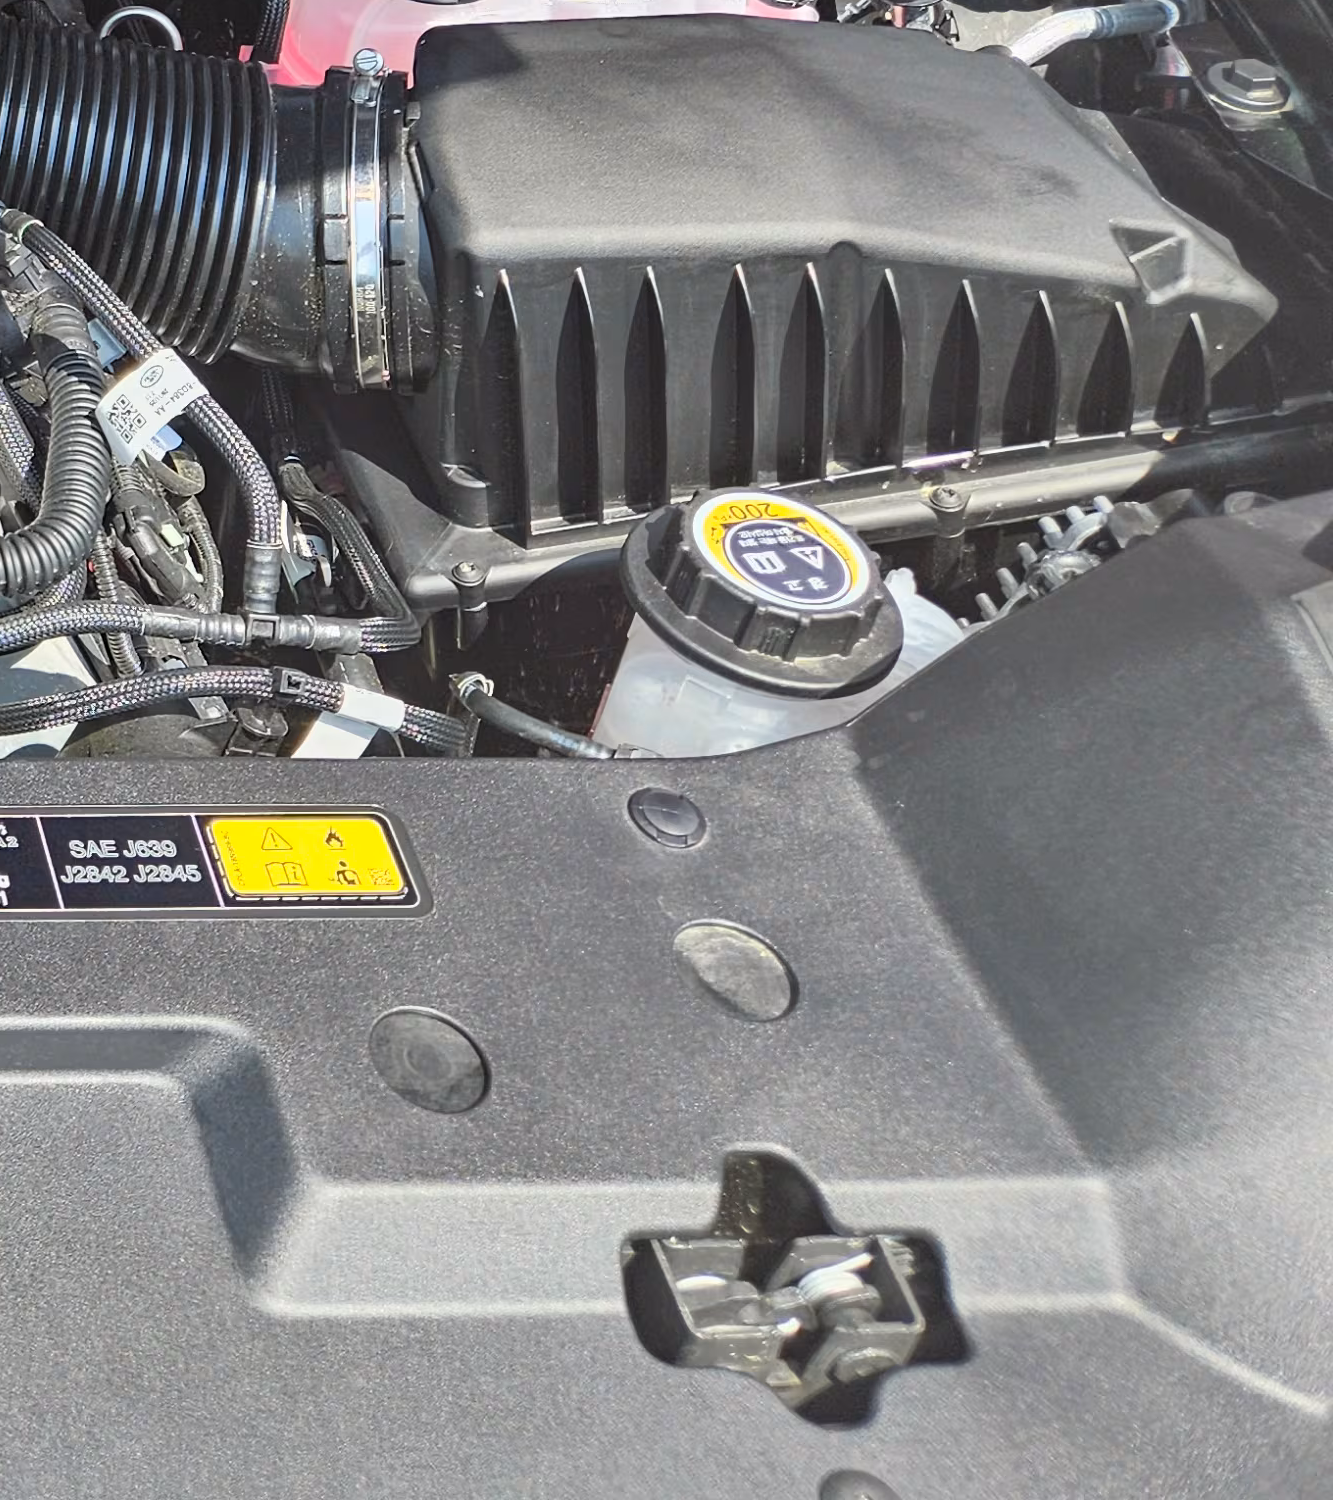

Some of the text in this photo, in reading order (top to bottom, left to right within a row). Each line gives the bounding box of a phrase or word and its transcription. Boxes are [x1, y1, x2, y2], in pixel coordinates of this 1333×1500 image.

[729, 503, 778, 520] 200
[69, 840, 177, 858] SAE J639
[61, 864, 202, 883] J2842 J2845
